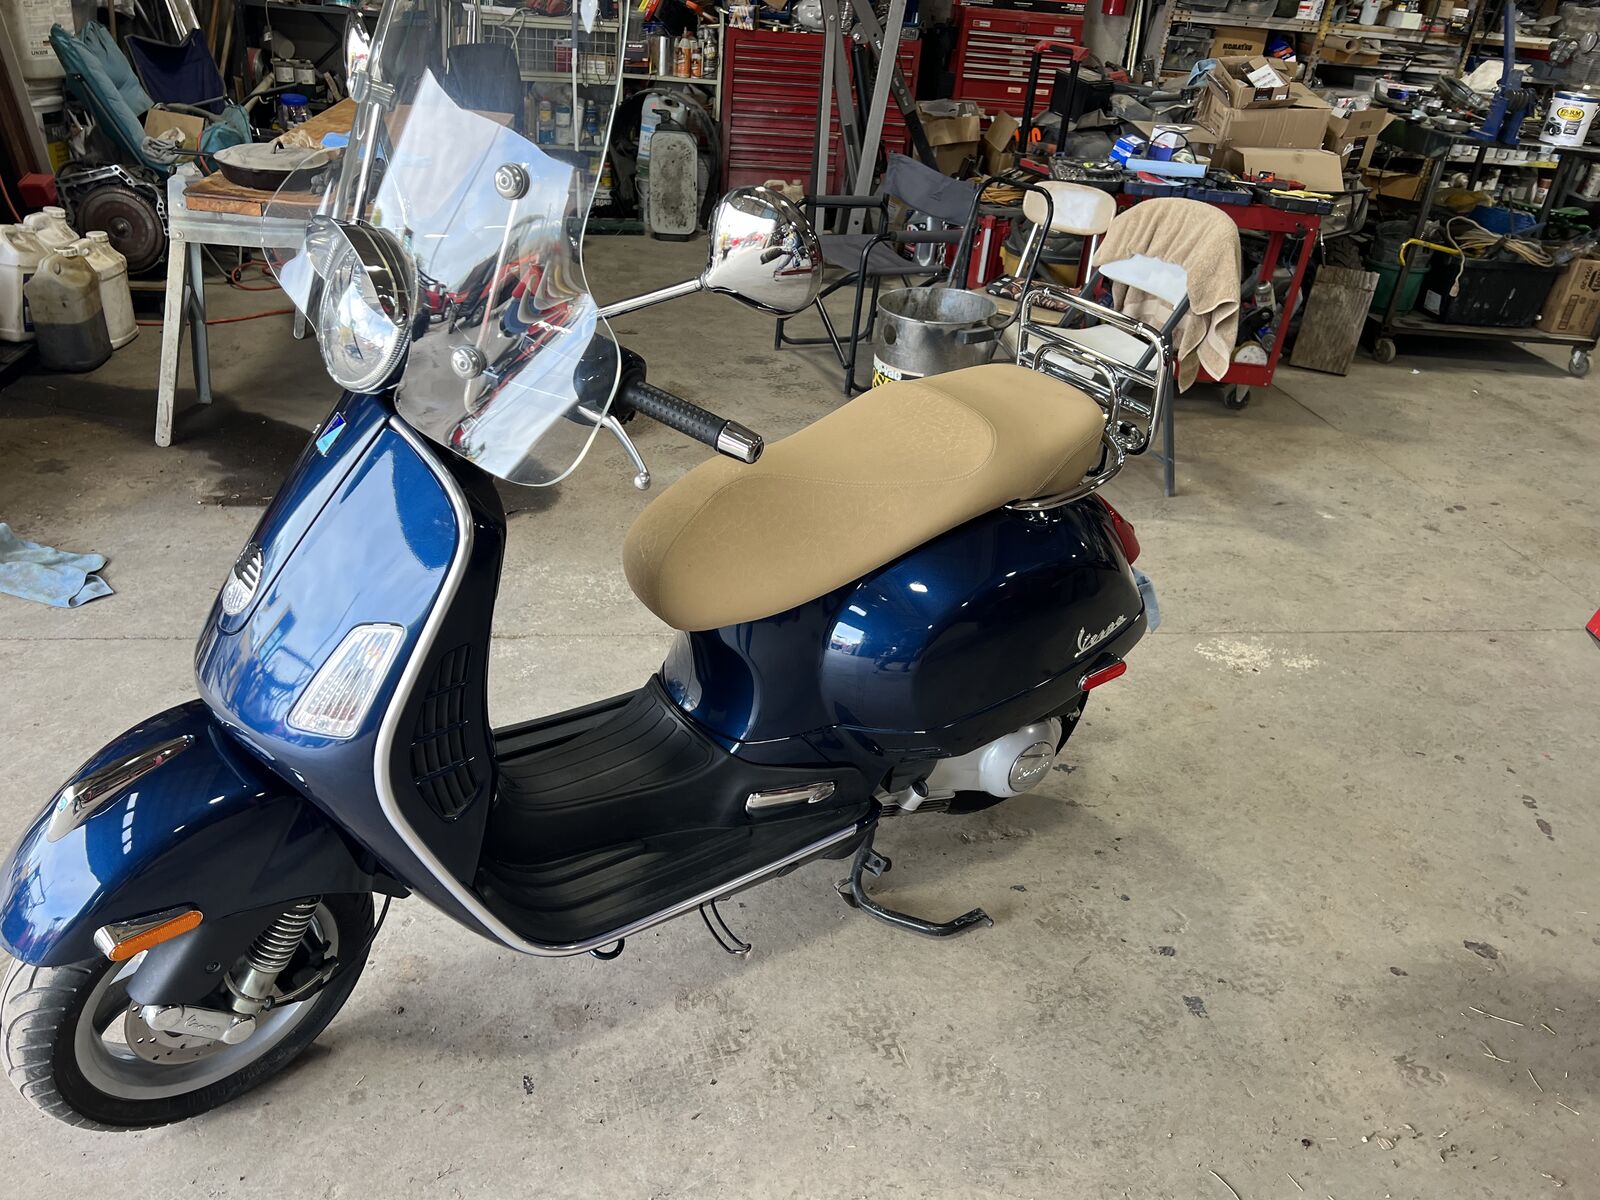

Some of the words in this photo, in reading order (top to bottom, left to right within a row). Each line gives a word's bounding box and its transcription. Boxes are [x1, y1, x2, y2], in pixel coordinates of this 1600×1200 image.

[1222, 43, 1253, 51] KOMATSU
[1560, 108, 1582, 116] FARM
[1074, 614, 1127, 658] Vespa
[184, 1014, 219, 1032] Vespa
